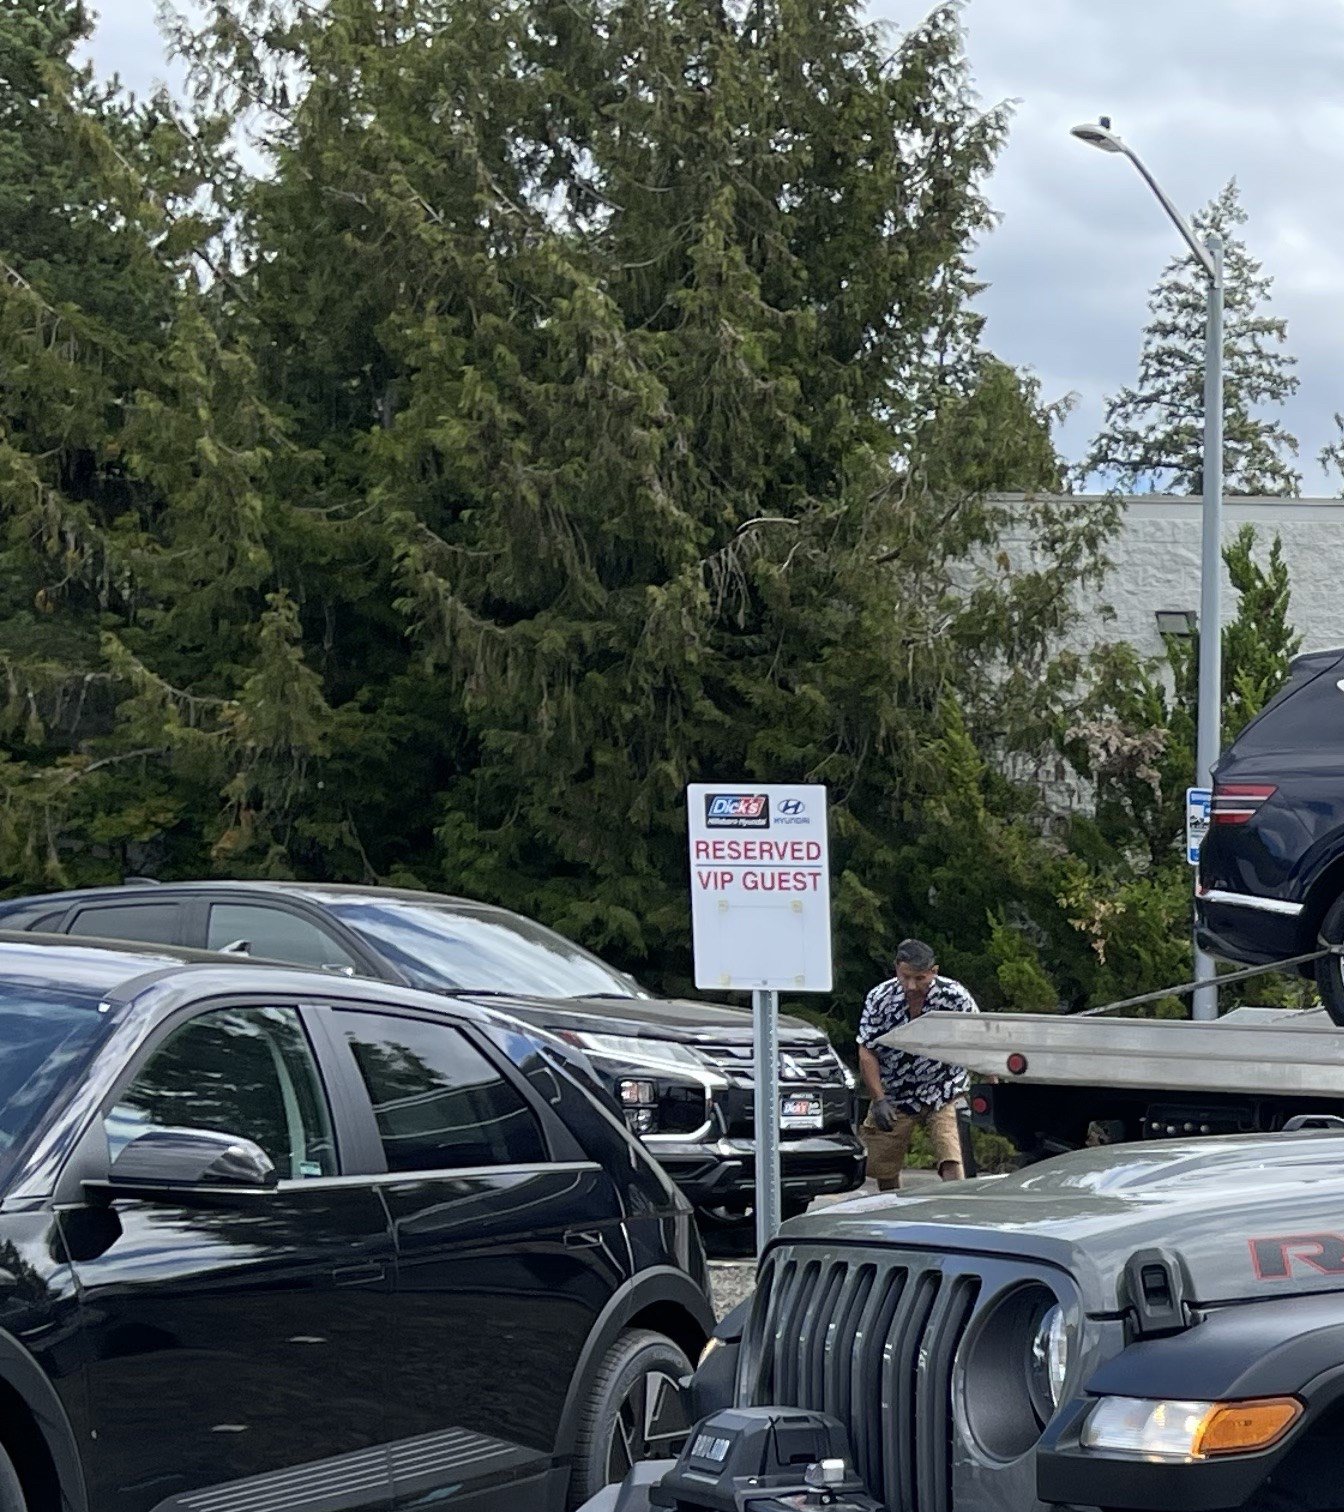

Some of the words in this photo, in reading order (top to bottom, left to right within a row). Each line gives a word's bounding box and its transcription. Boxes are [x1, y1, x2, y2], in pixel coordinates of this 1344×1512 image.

[695, 840, 821, 861] RESERVED
[697, 871, 734, 890] VIP
[742, 871, 822, 891] GUEST
